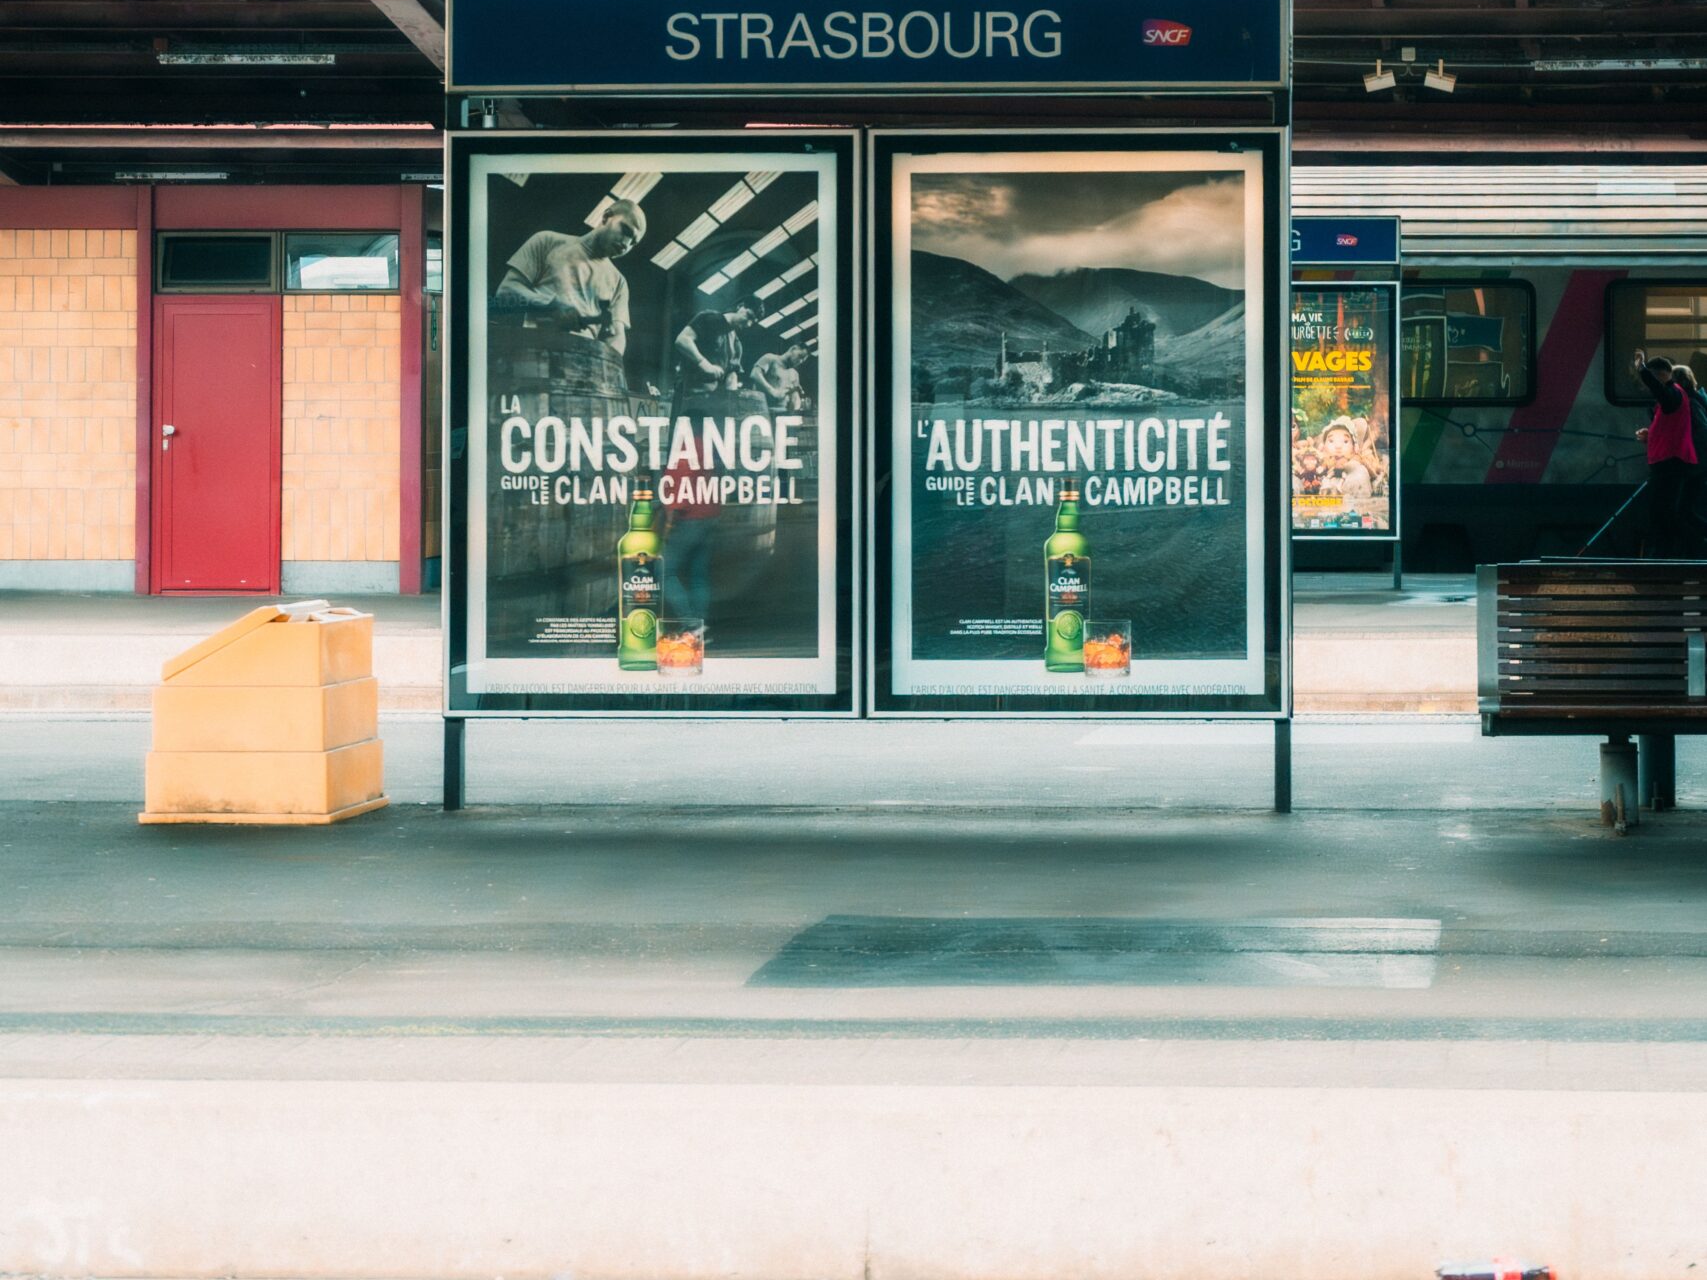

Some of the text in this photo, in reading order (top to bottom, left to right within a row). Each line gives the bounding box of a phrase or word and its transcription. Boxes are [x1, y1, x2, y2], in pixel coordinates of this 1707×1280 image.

[665, 9, 1062, 61] STRASBOURG
[1143, 29, 1190, 43] SNCF
[1308, 312, 1323, 322] VIE
[1292, 325, 1332, 340] URGETTE
[501, 394, 521, 414] LA
[501, 415, 803, 473] CONSTANCE
[917, 411, 1231, 473] L'AUTHENTICITÉ
[501, 475, 550, 490] GUIDE
[554, 475, 803, 505] CLAN CAMPBELL
[926, 477, 975, 491] GUIDE
[531, 491, 550, 505] LE
[980, 475, 1231, 506] CLAN CAMPBELL
[957, 492, 975, 505] LE
[631, 575, 654, 584] CLAN
[1057, 577, 1080, 585] CLAN
